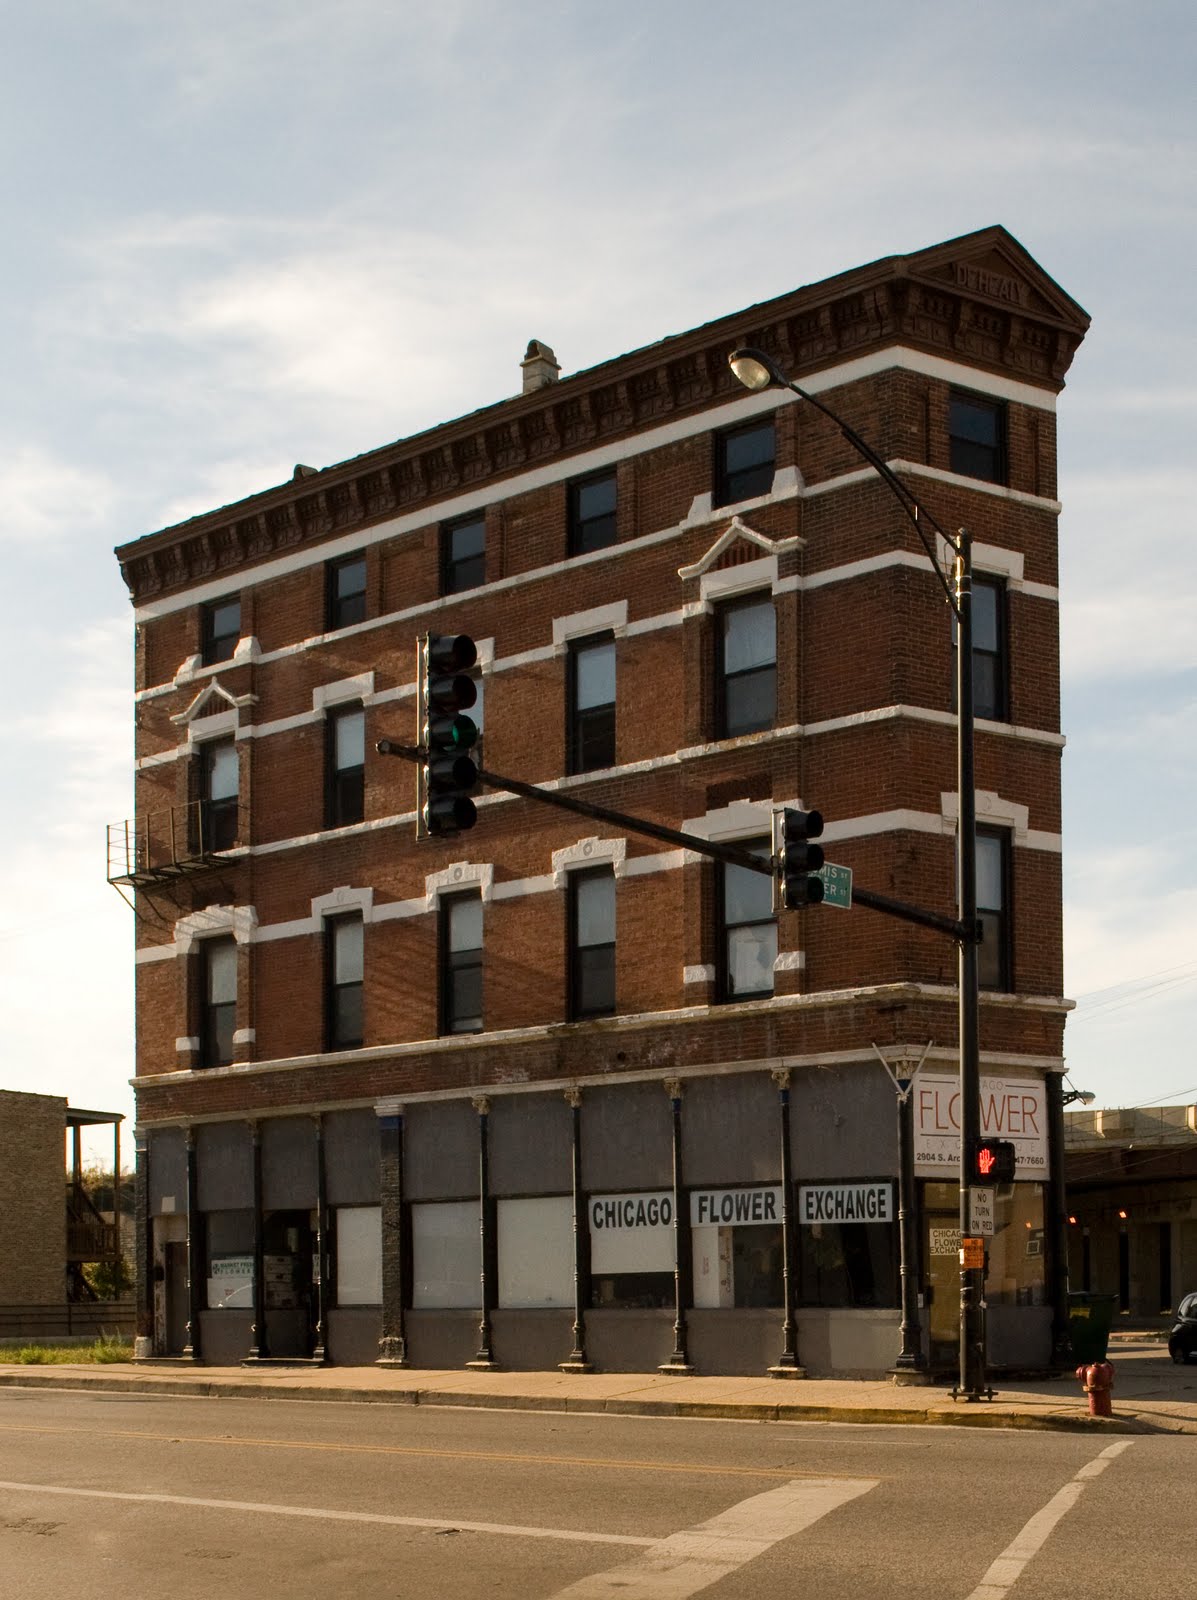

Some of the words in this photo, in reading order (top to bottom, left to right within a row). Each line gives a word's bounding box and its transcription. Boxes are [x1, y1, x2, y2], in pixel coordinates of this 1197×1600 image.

[819, 865, 837, 878] MIS
[823, 883, 837, 896] ER
[916, 1152, 936, 1161] 2904
[947, 1154, 961, 1162] Arc
[977, 1193, 987, 1203] NO
[592, 1197, 672, 1229] CHICAGO
[698, 1191, 777, 1223] FLOWER
[805, 1188, 887, 1219] EXCHANGE
[975, 1206, 990, 1217] TURN
[972, 1220, 980, 1230] ON
[982, 1220, 993, 1230] RED
[932, 1230, 961, 1238] CHICAG
[934, 1239, 961, 1247] FLOWE
[930, 1246, 960, 1254] EXCHAN
